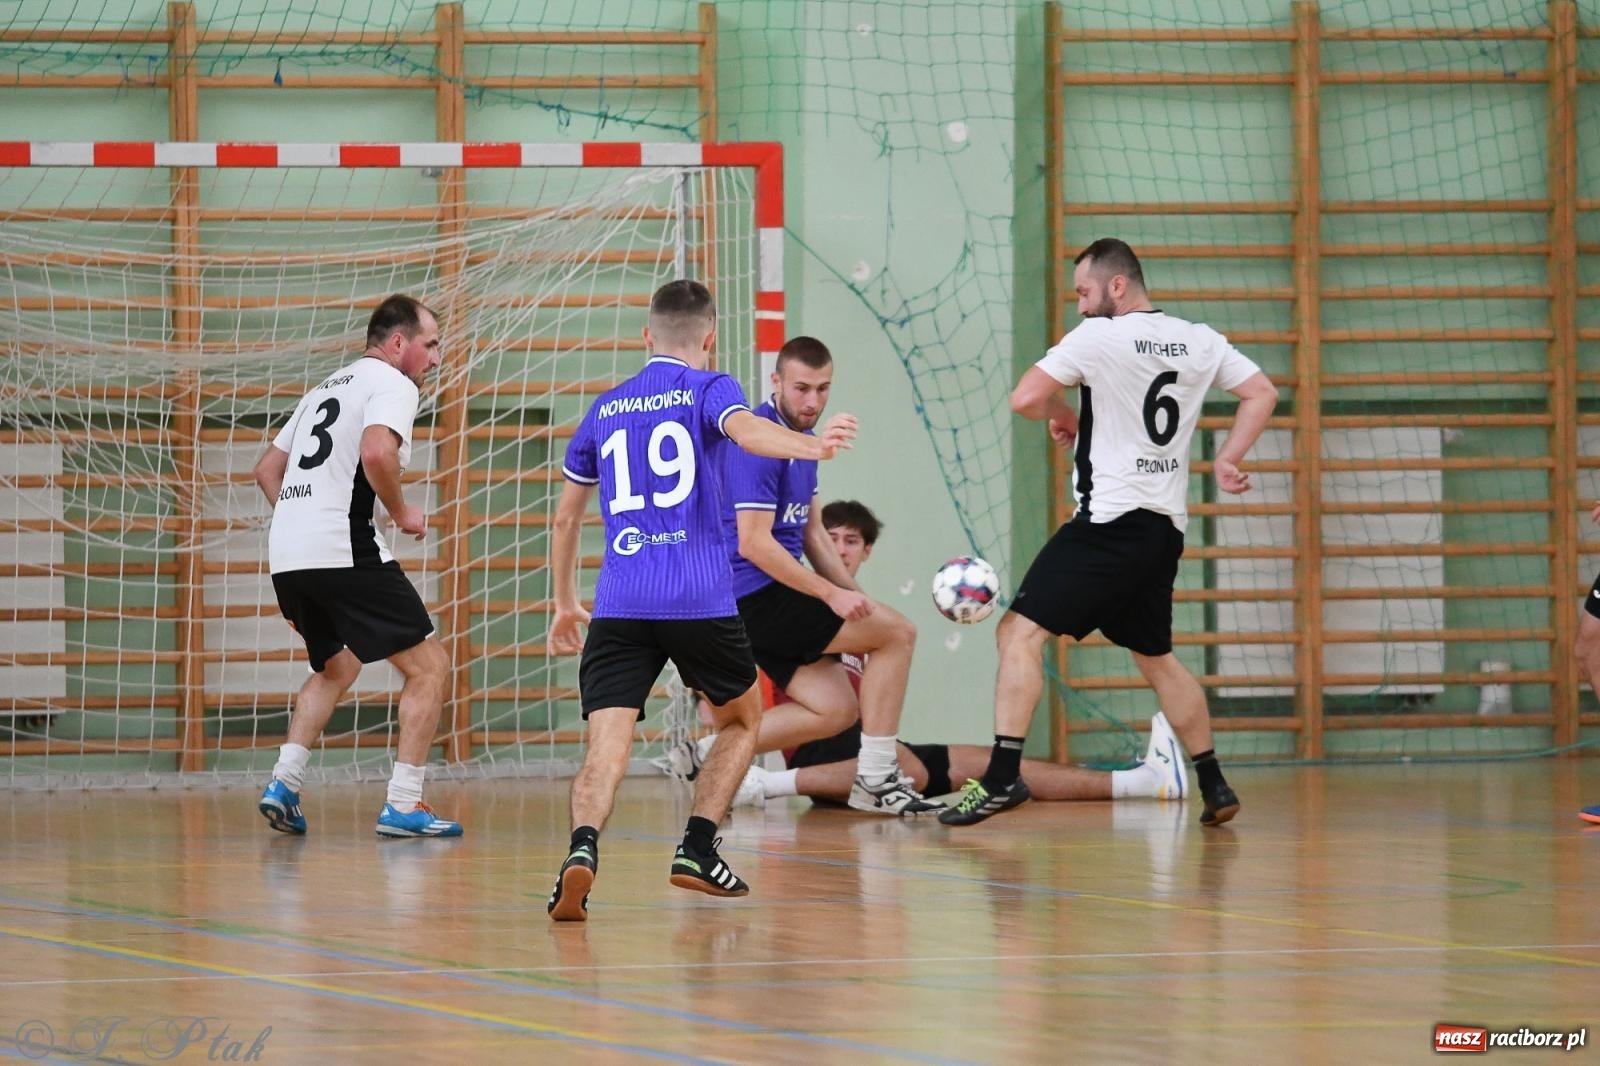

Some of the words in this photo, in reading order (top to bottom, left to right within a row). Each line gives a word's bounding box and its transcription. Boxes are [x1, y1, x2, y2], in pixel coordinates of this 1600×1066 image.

[1134, 340, 1189, 357] WICHER
[316, 374, 354, 390] ICHER
[598, 389, 694, 420] NOWAKOWSKI
[298, 397, 341, 470] 3
[1142, 371, 1180, 446] 6
[601, 420, 696, 515] 19
